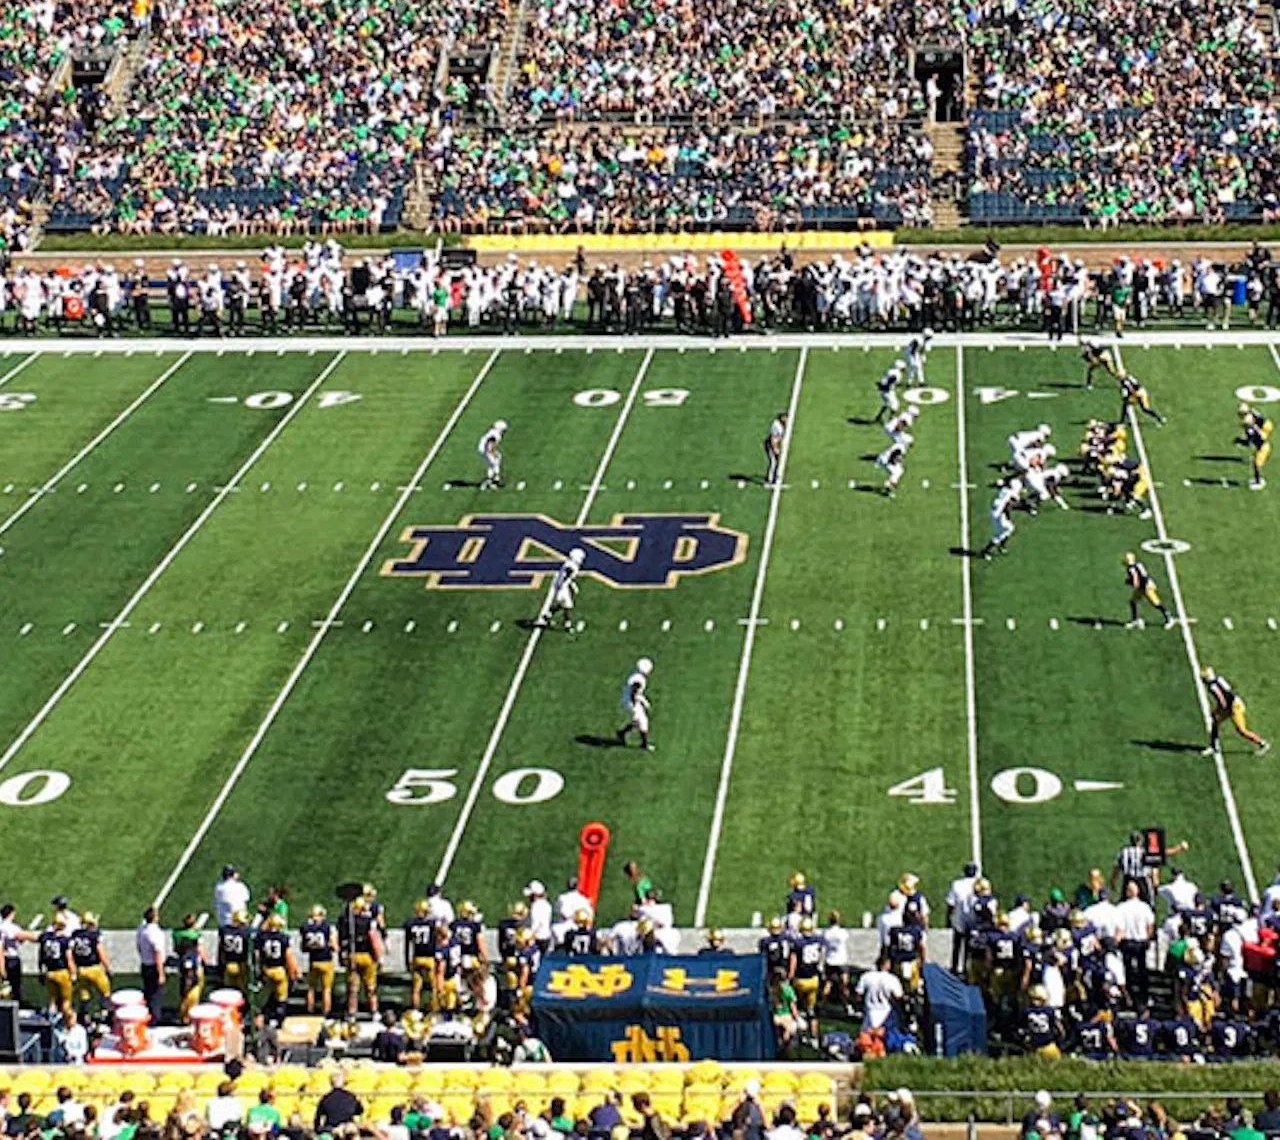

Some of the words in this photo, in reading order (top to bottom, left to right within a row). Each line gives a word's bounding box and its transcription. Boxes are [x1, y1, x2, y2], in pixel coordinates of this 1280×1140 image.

[378, 512, 749, 589] ND
[385, 768, 565, 805] 50
[888, 766, 1063, 804] 40
[547, 964, 634, 998] ND
